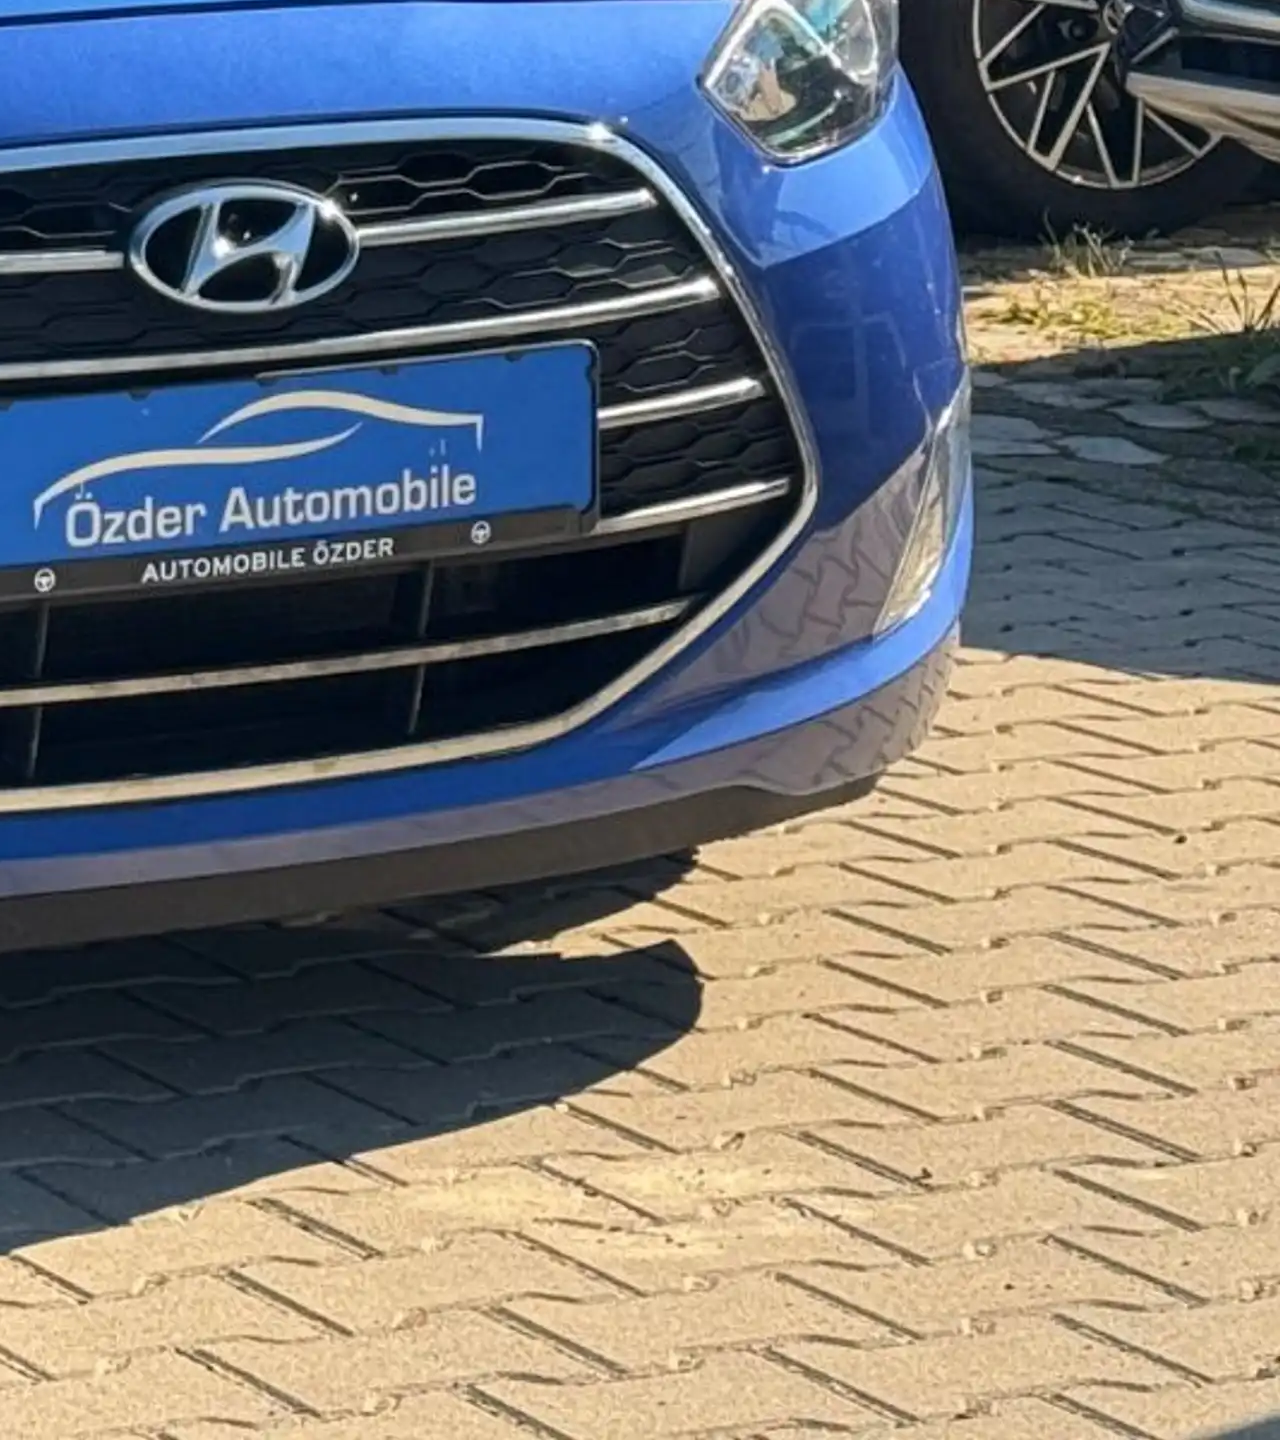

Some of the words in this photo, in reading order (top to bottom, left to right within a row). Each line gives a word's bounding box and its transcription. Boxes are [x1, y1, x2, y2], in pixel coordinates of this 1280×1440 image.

[66, 491, 208, 548] Özder
[219, 464, 476, 532] Automobile
[141, 547, 305, 583] AUTOMOBILE
[312, 537, 395, 565] ÖZDER
